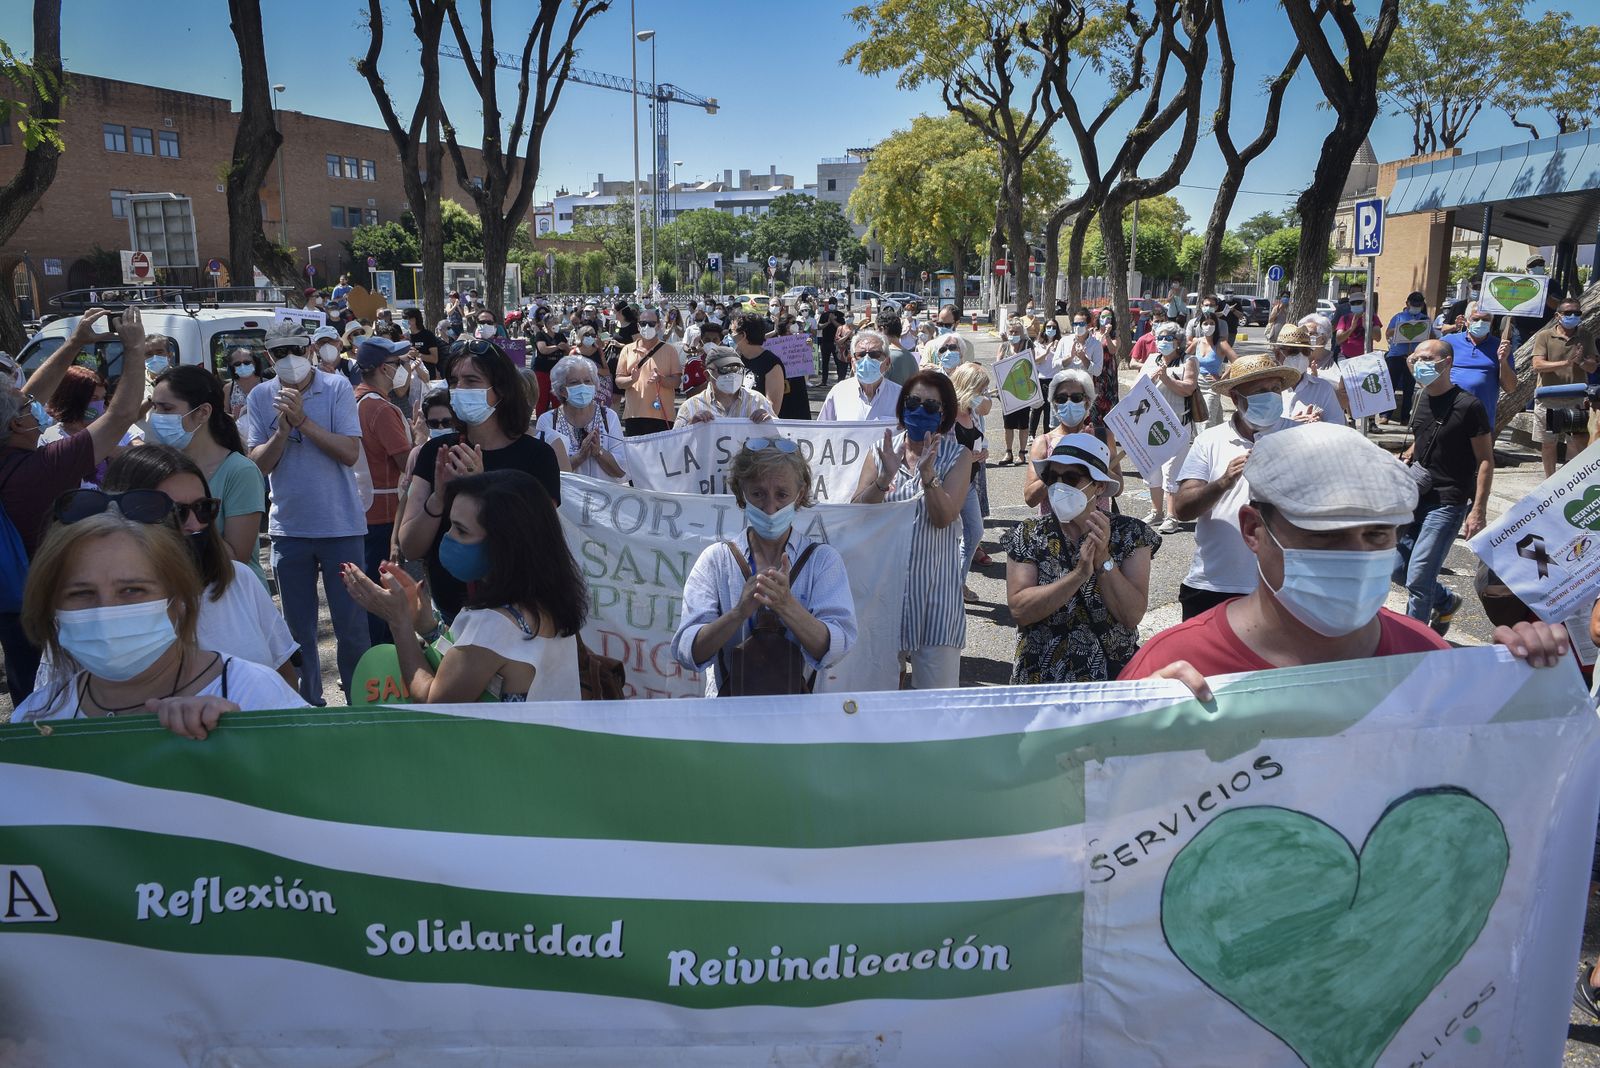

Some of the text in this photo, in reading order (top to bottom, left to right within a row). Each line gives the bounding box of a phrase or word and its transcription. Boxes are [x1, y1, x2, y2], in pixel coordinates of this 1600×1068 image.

[659, 431, 860, 478] LA SDAD
[1489, 510, 1537, 548] Luchemos
[1536, 495, 1554, 515] por
[1553, 488, 1566, 500] lo
[1089, 755, 1284, 884] SERVICIOS
[3, 870, 51, 918] A
[135, 875, 338, 925] Reflexión
[365, 918, 625, 959] Solidaridad
[667, 934, 1013, 987] Reivindicación
